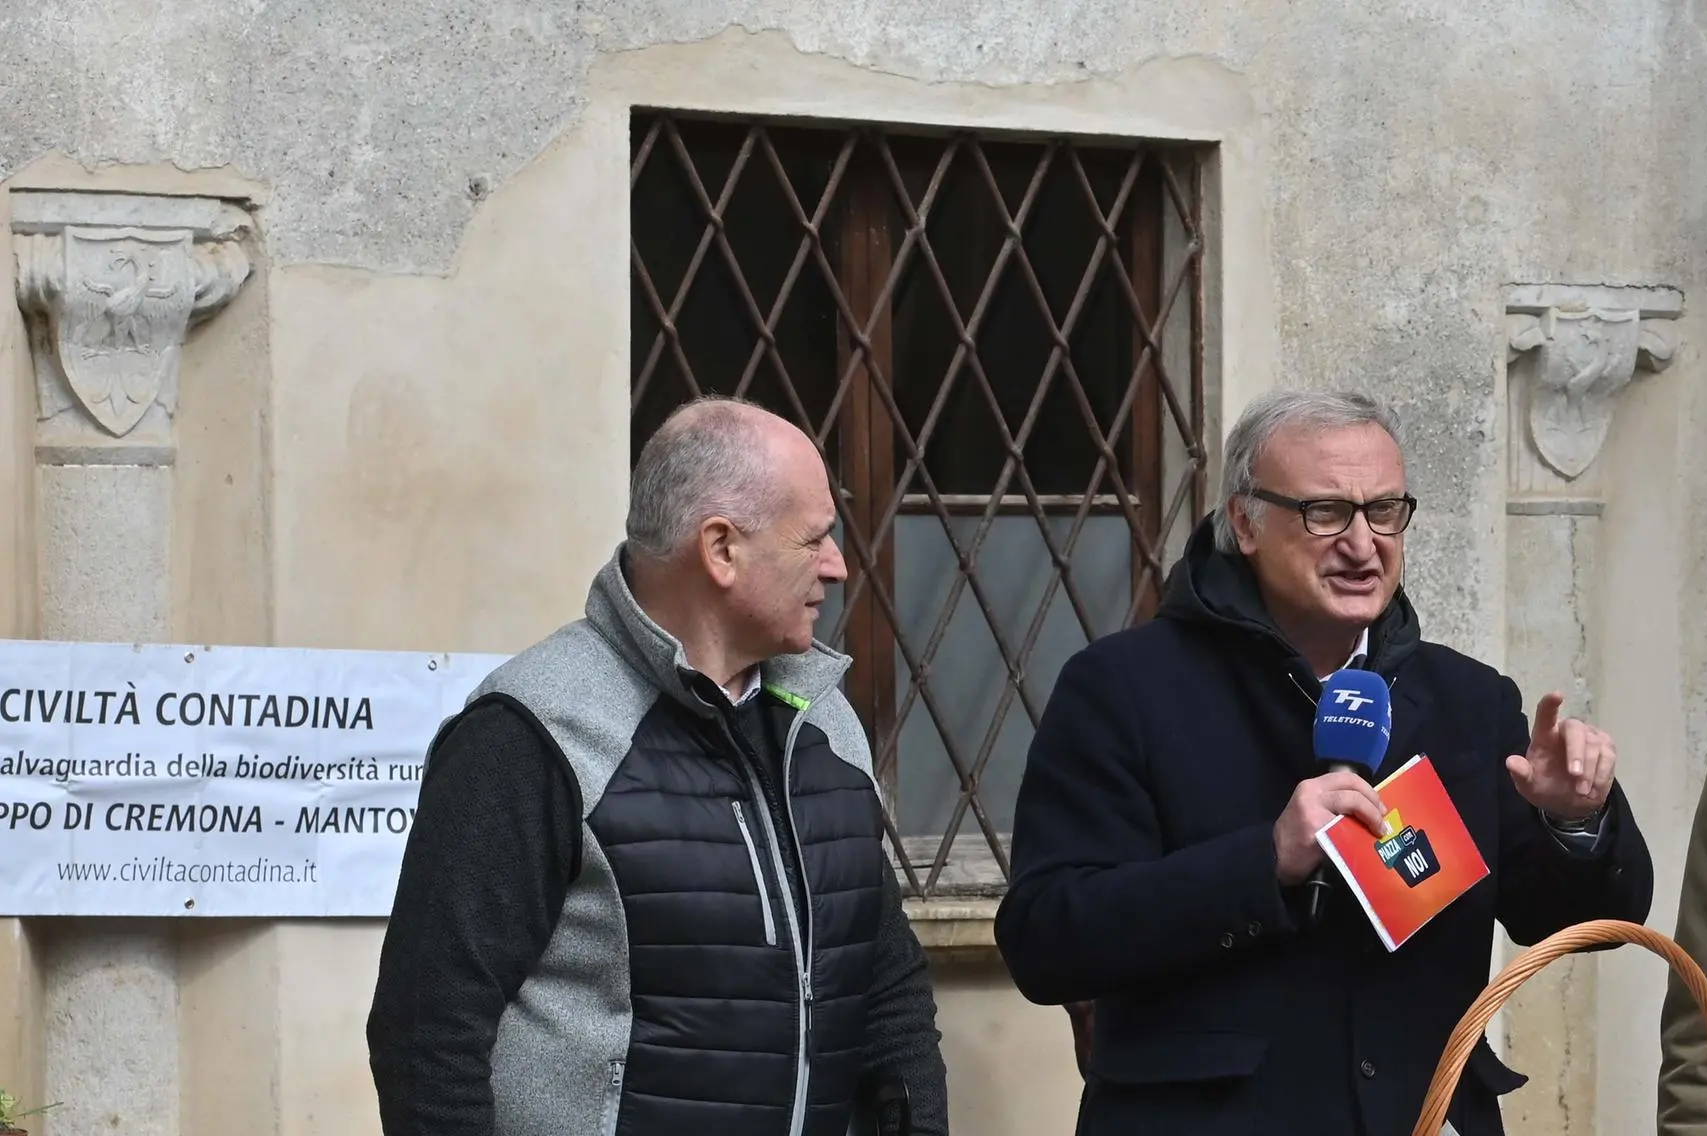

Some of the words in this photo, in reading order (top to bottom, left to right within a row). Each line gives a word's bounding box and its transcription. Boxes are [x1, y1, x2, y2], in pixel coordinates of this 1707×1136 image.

[0, 681, 141, 726] CIVILTÀ
[156, 691, 374, 731] CONTADINA
[1322, 715, 1375, 728] TELETUTTO
[0, 750, 157, 782] alvaguardia
[167, 753, 227, 779] della
[235, 754, 379, 782] biodiversità
[63, 802, 94, 831] DI
[105, 803, 264, 834] CREMONA
[295, 806, 416, 834] MANTO
[1377, 838, 1402, 863] PIAZZA
[1403, 848, 1429, 879] NOI
[57, 856, 318, 885] www.civiltacontadina.it
